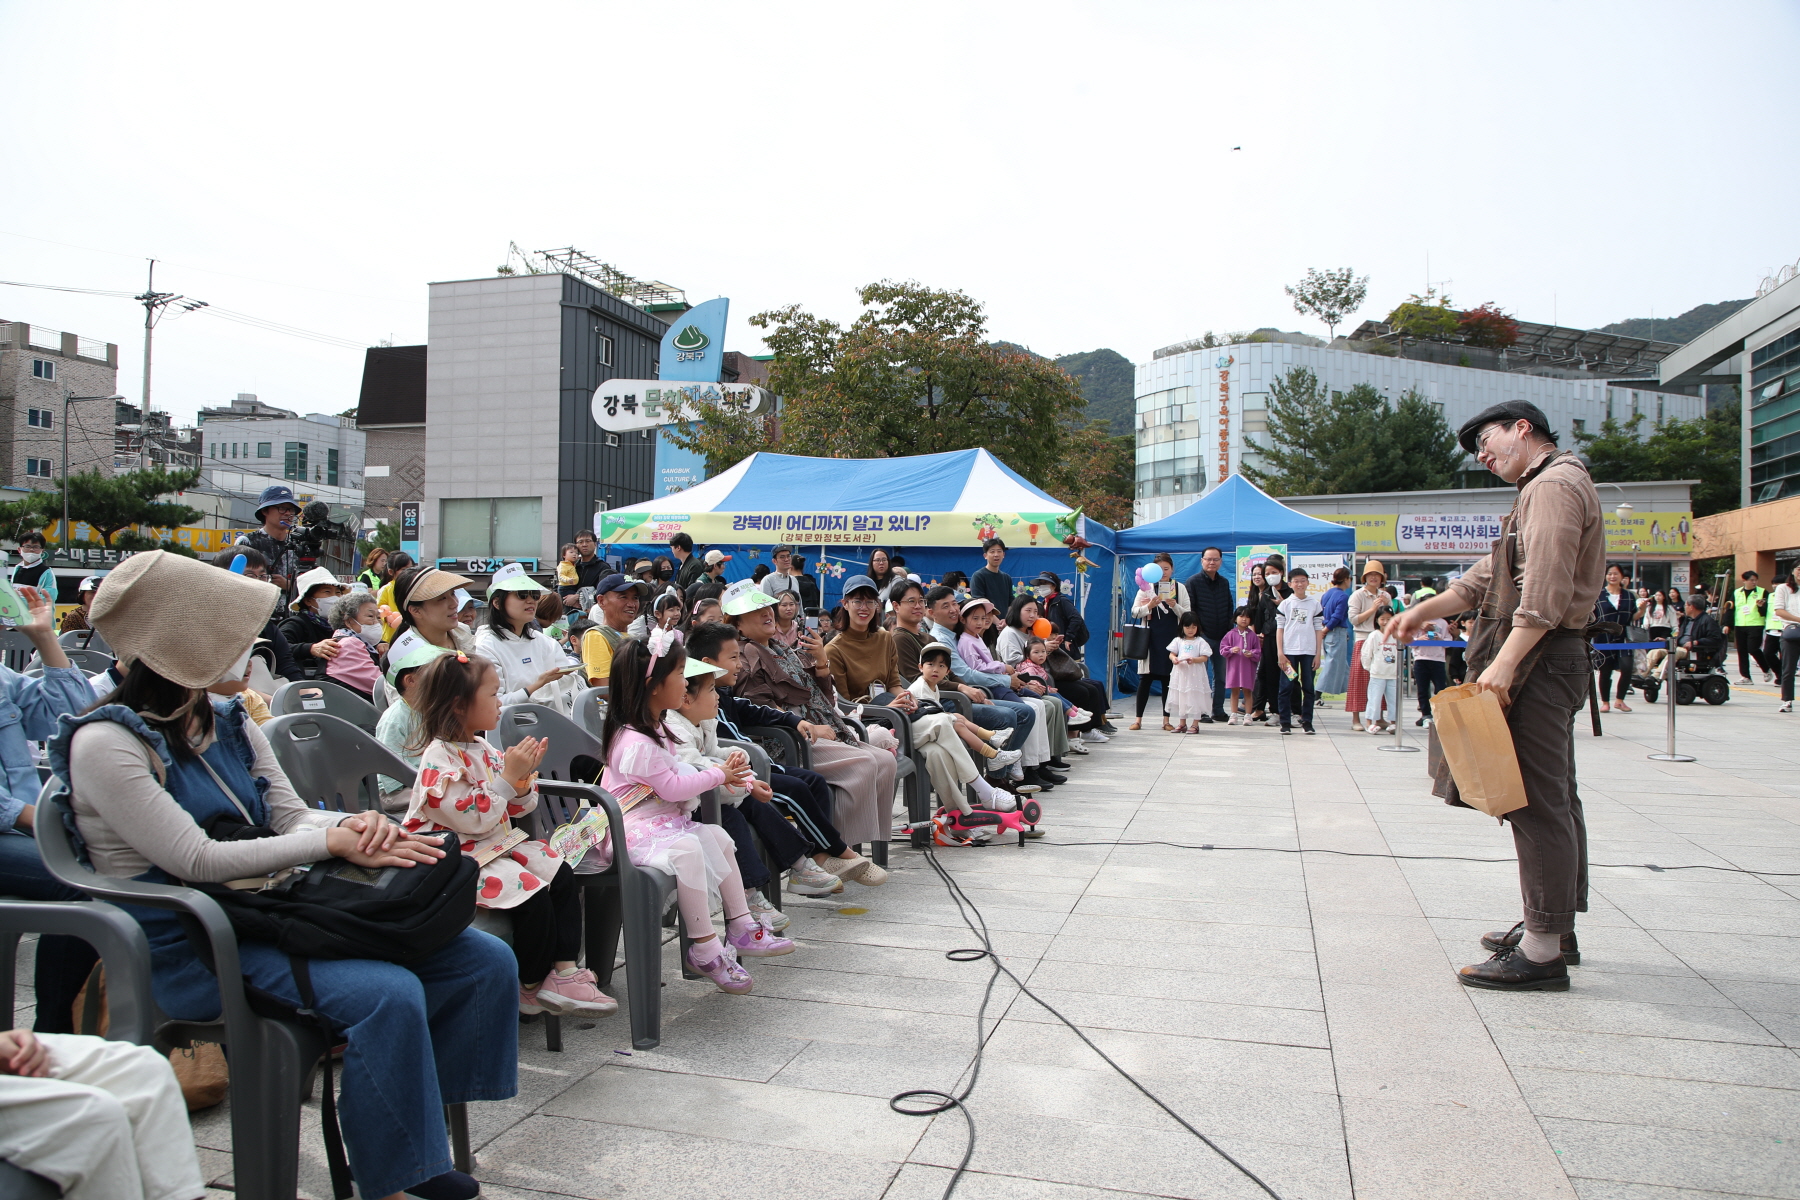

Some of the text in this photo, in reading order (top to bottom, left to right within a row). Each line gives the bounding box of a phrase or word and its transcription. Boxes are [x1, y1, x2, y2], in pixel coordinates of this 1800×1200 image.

[676, 352, 705, 362] 강북구
[691, 474, 697, 482] &
[405, 509, 416, 518] GS
[405, 518, 416, 526] 25
[732, 515, 931, 532] 강북이! 어디까지 알고 있니?
[1424, 541, 1456, 549] 상담전화
[54, 547, 139, 564] 스마트도서
[467, 557, 504, 573] GS25
